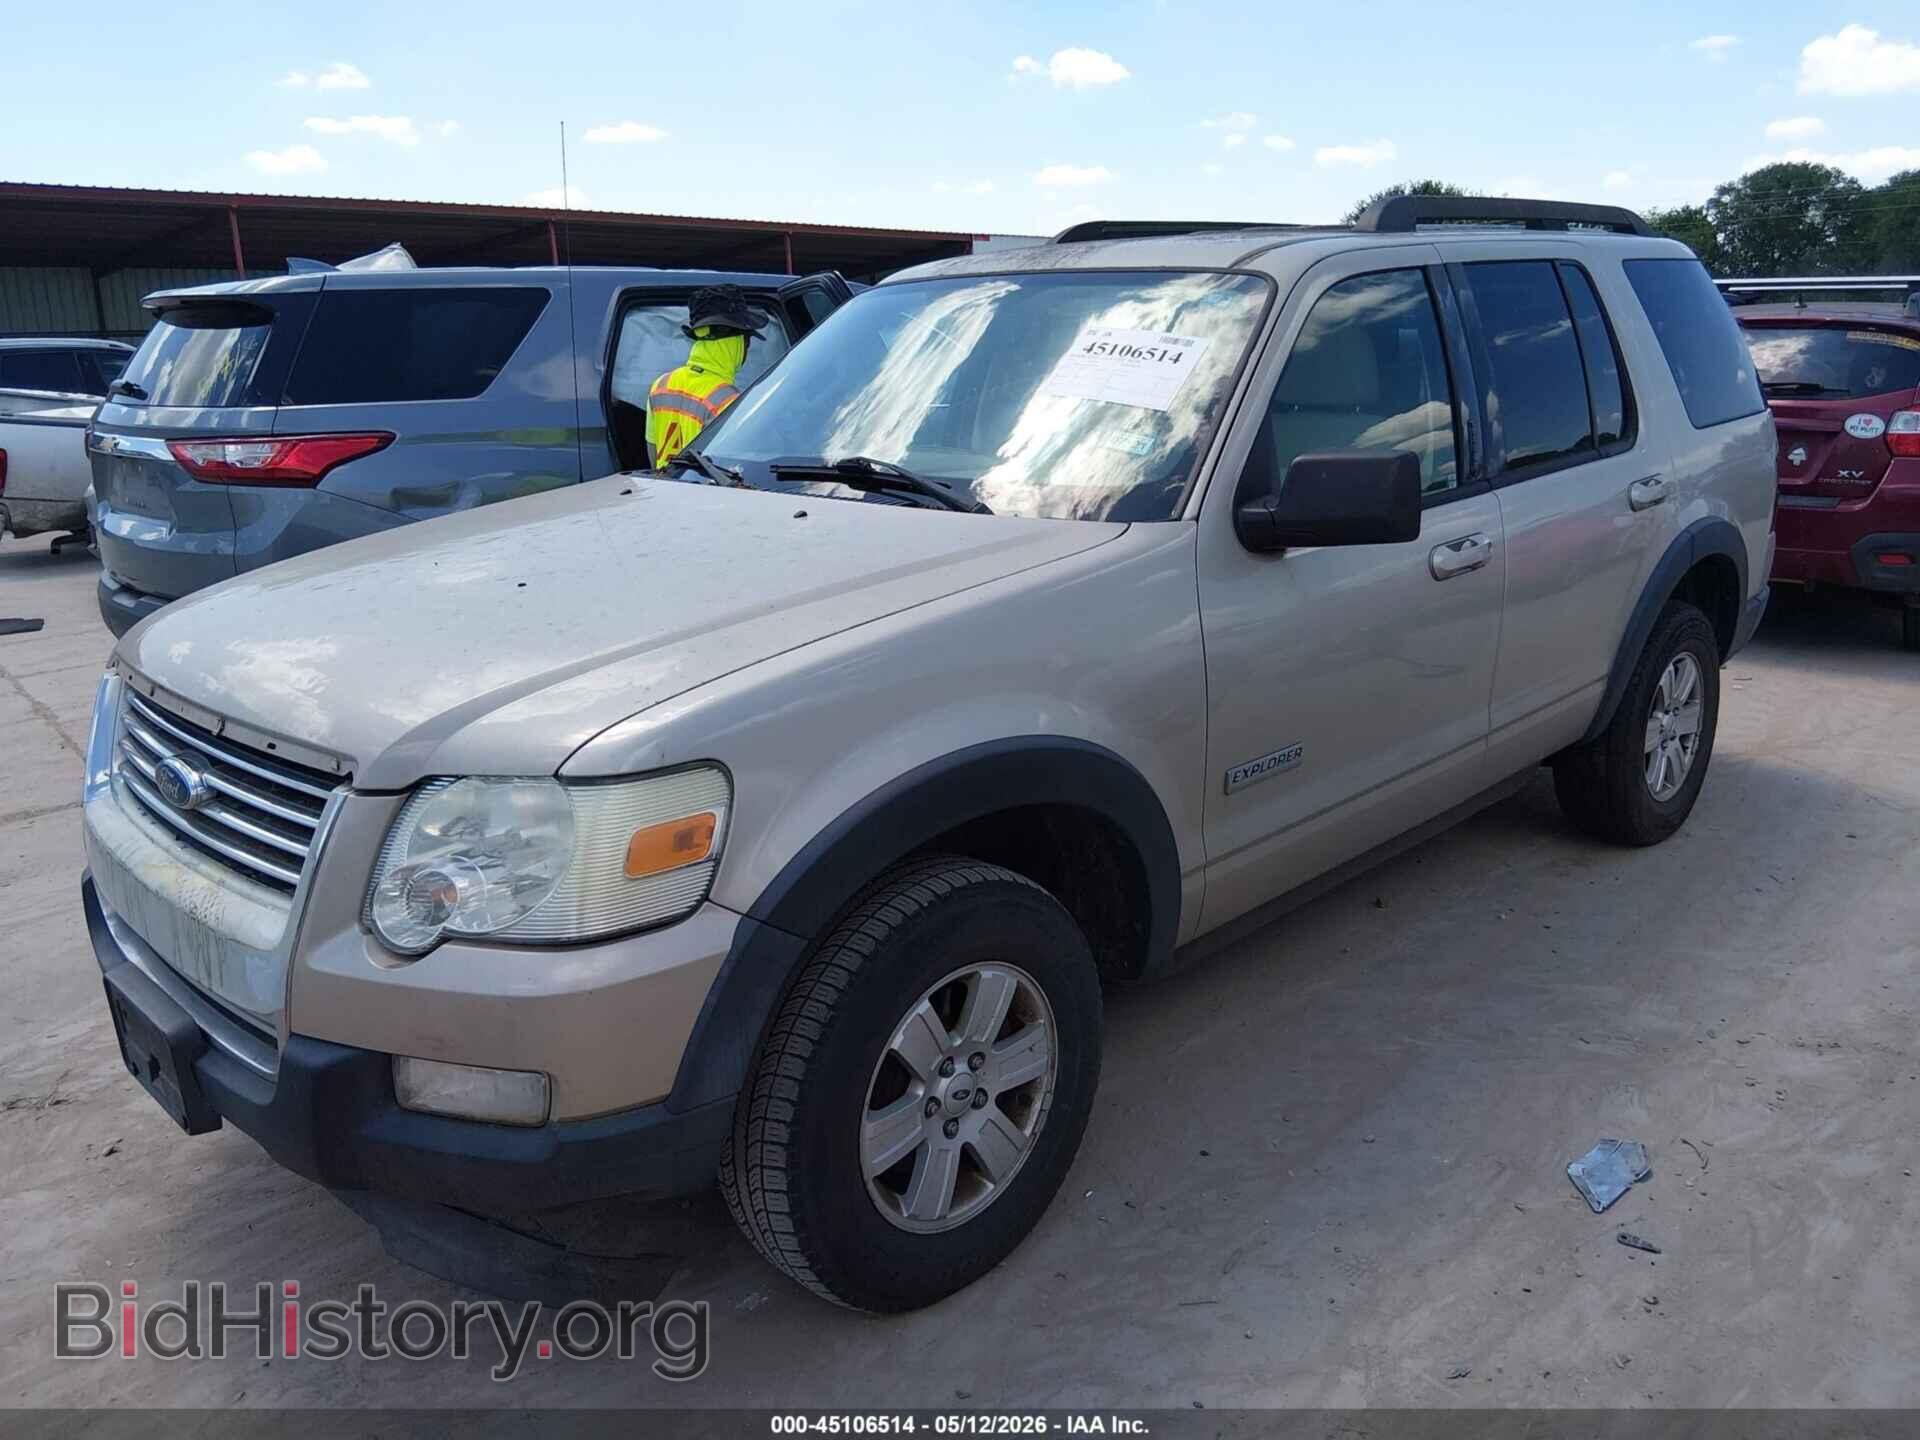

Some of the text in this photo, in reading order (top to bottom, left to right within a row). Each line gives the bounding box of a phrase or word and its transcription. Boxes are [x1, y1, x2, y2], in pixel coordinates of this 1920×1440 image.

[1083, 342, 1183, 364] 45106514
[1837, 470, 1864, 478] XV
[1231, 746, 1303, 784] EXPLORER
